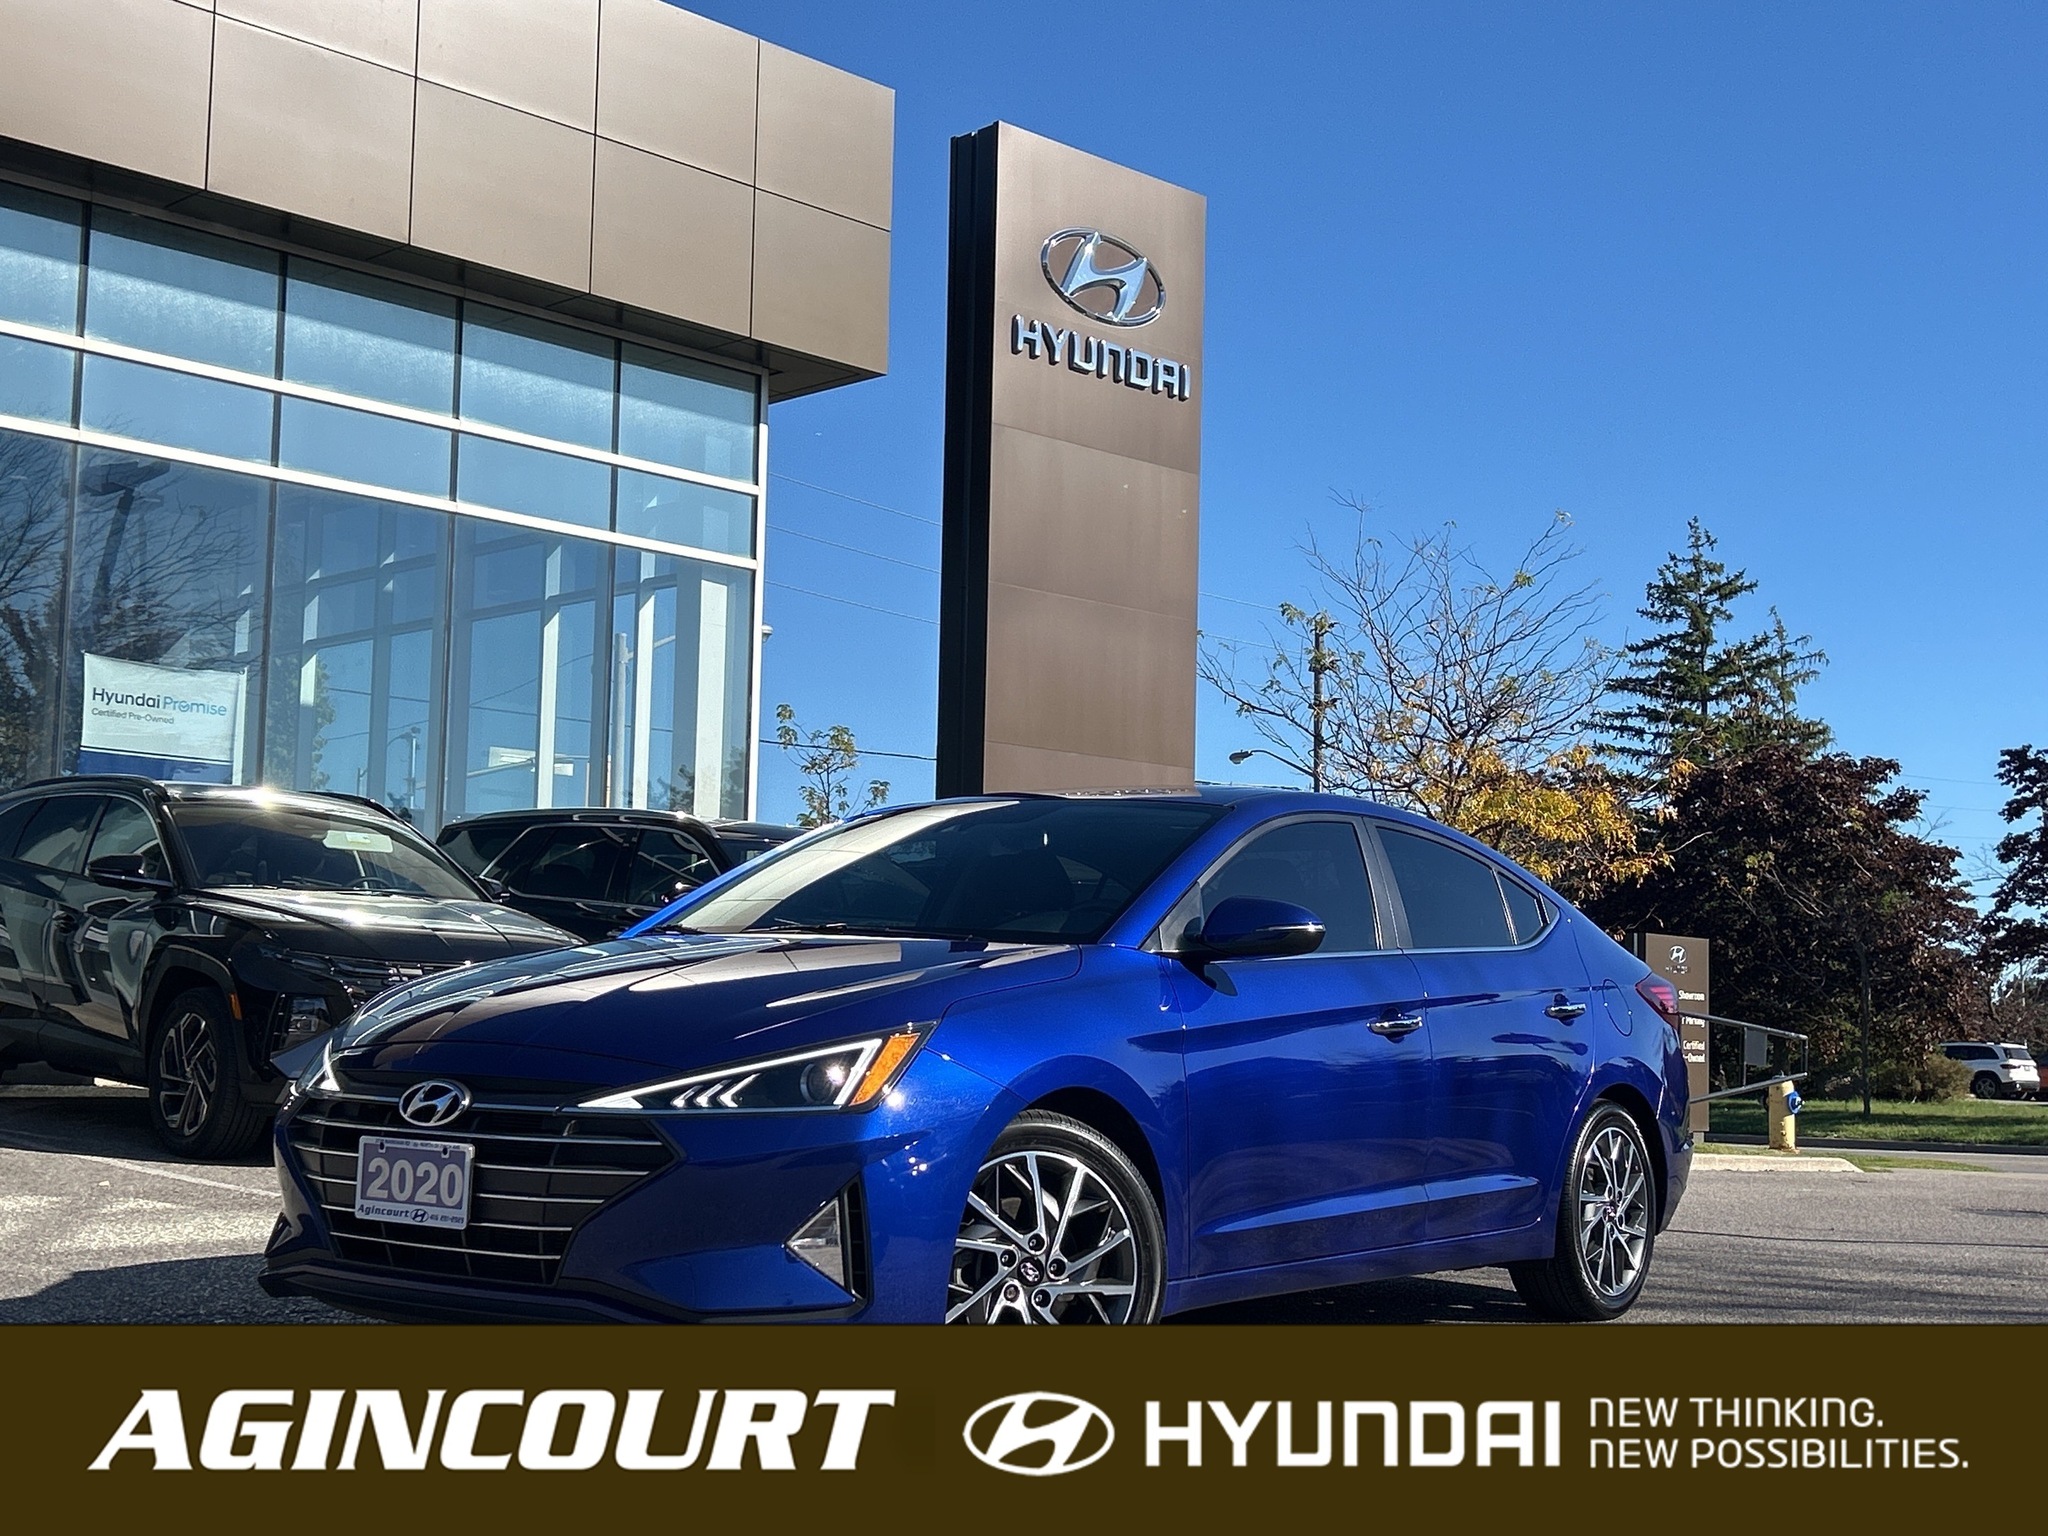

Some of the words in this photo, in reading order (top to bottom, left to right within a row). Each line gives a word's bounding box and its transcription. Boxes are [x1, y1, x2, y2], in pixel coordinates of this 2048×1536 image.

[1011, 314, 1190, 402] HYUNDAI
[92, 687, 160, 709] Hyundai
[163, 696, 227, 716] Promise
[92, 708, 127, 720] Certified
[128, 712, 175, 724] Pre-Owned
[366, 1157, 463, 1206] 2020
[358, 1204, 409, 1217] Agincourt
